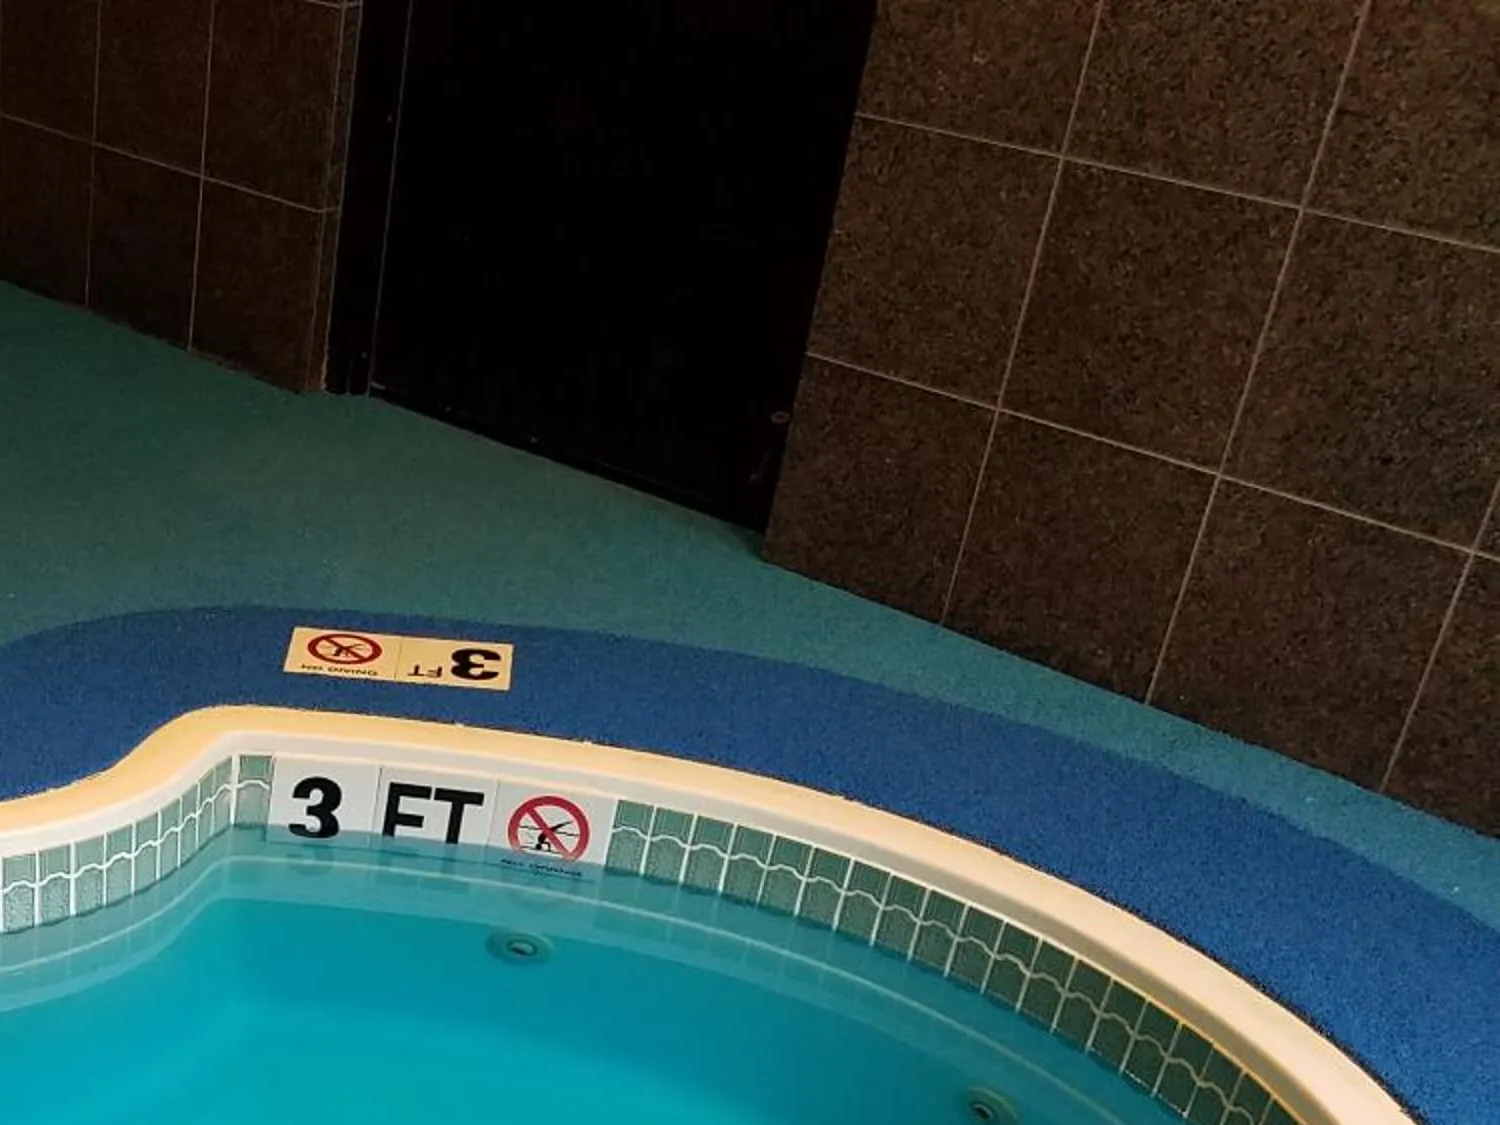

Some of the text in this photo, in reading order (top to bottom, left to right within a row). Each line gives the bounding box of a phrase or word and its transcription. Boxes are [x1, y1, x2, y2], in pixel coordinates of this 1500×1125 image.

[407, 648, 502, 680] 3 FT
[288, 776, 485, 845] 3 FT
